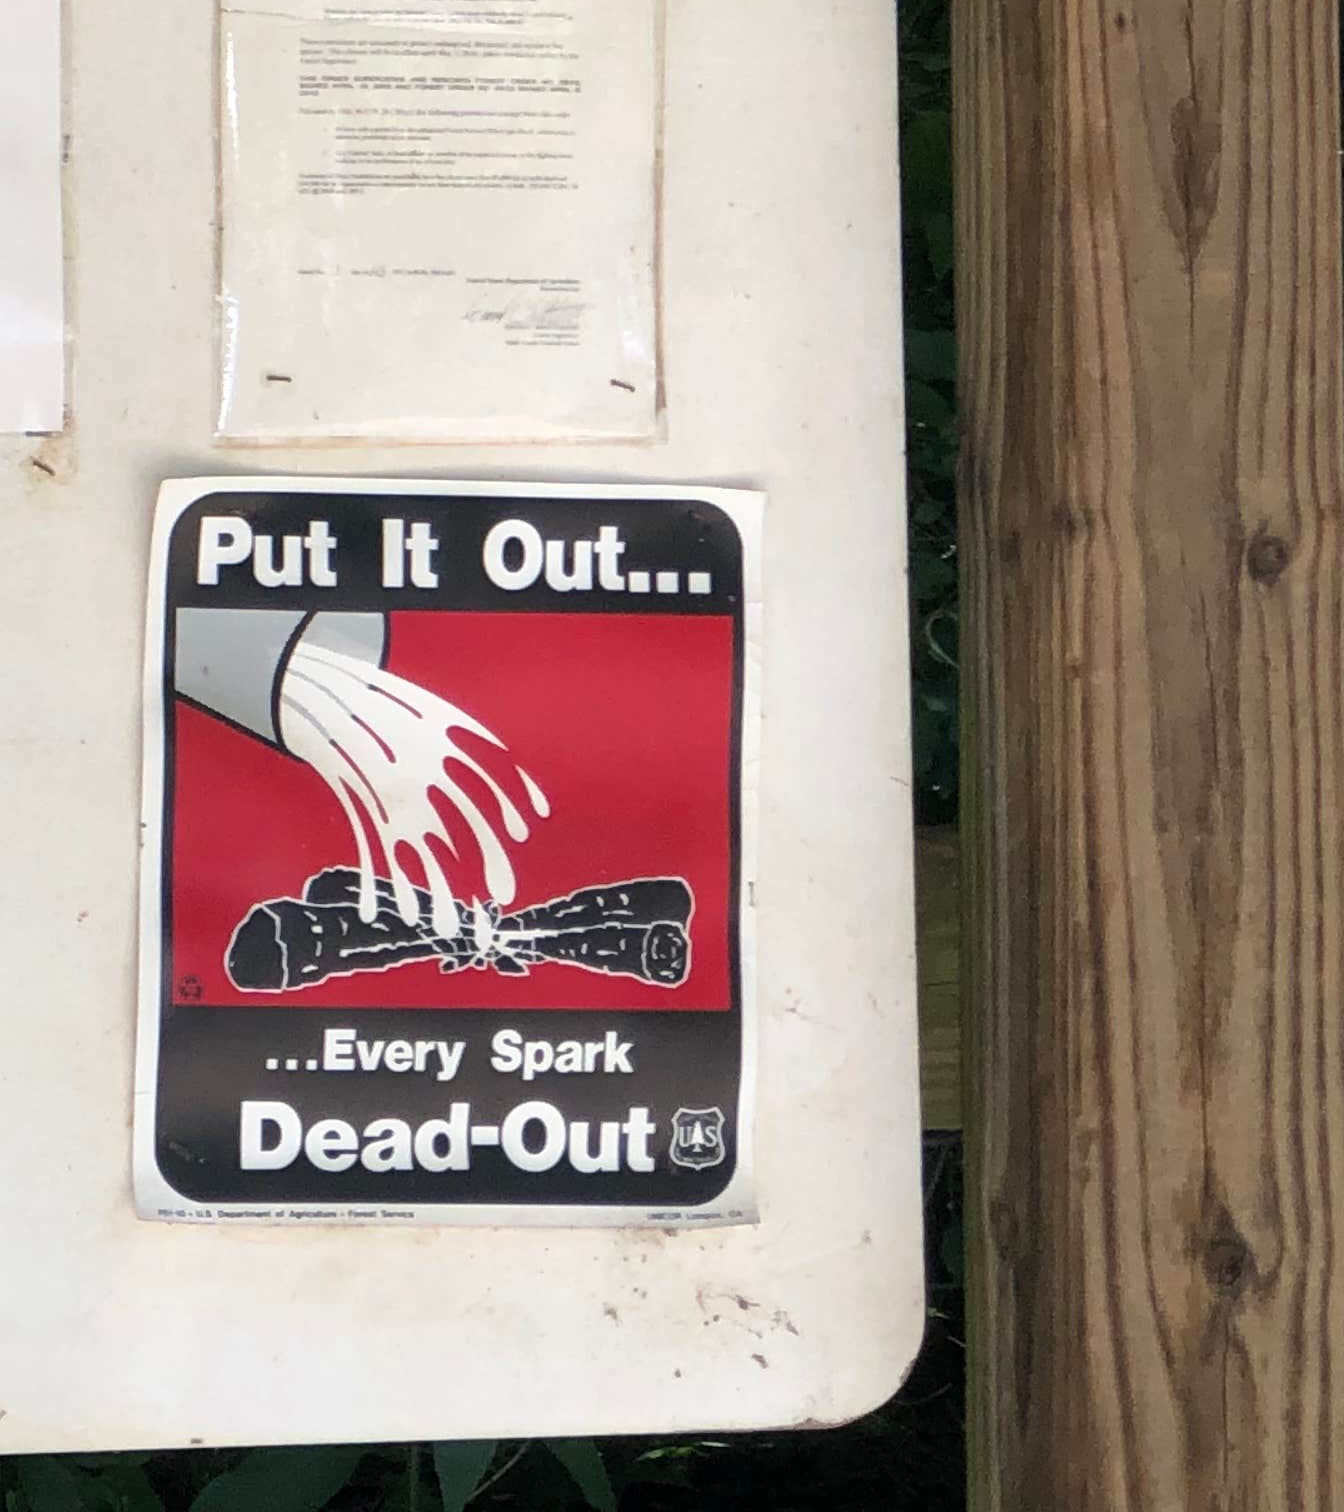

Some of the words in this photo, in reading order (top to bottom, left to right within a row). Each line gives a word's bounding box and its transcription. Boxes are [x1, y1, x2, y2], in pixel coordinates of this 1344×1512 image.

[197, 515, 337, 588] Put
[382, 518, 439, 589] It
[482, 518, 712, 594] Out...
[266, 1028, 466, 1081] ...Every
[490, 1028, 634, 1081] Spark
[240, 1100, 657, 1173] Dead-Out
